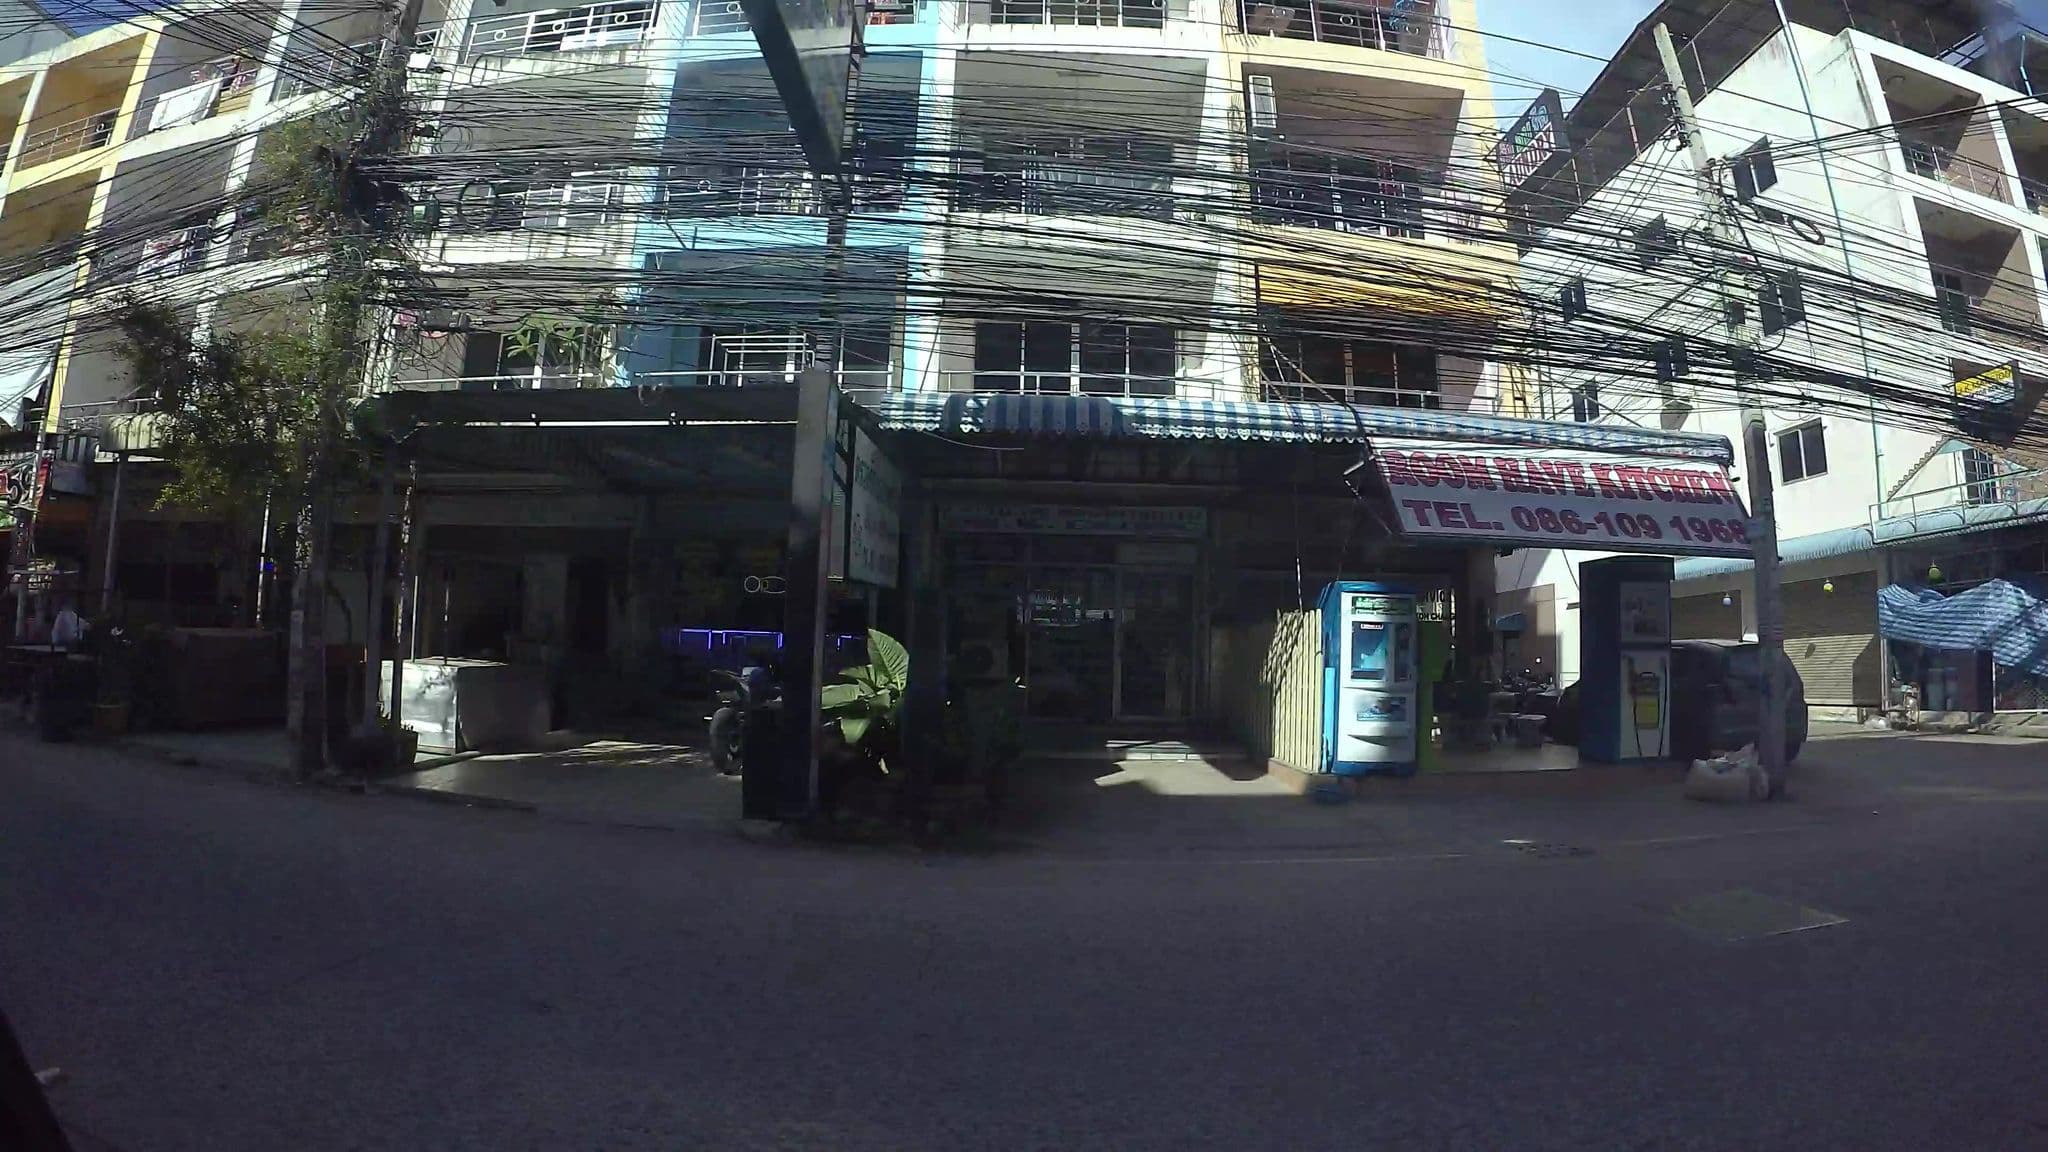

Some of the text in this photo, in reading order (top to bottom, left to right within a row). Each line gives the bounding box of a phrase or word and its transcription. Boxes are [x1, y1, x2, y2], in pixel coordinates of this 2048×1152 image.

[1380, 451, 1734, 504] ROOM HAVE KITCHEN
[1401, 499, 1748, 545] TEL. 086-109 1968
